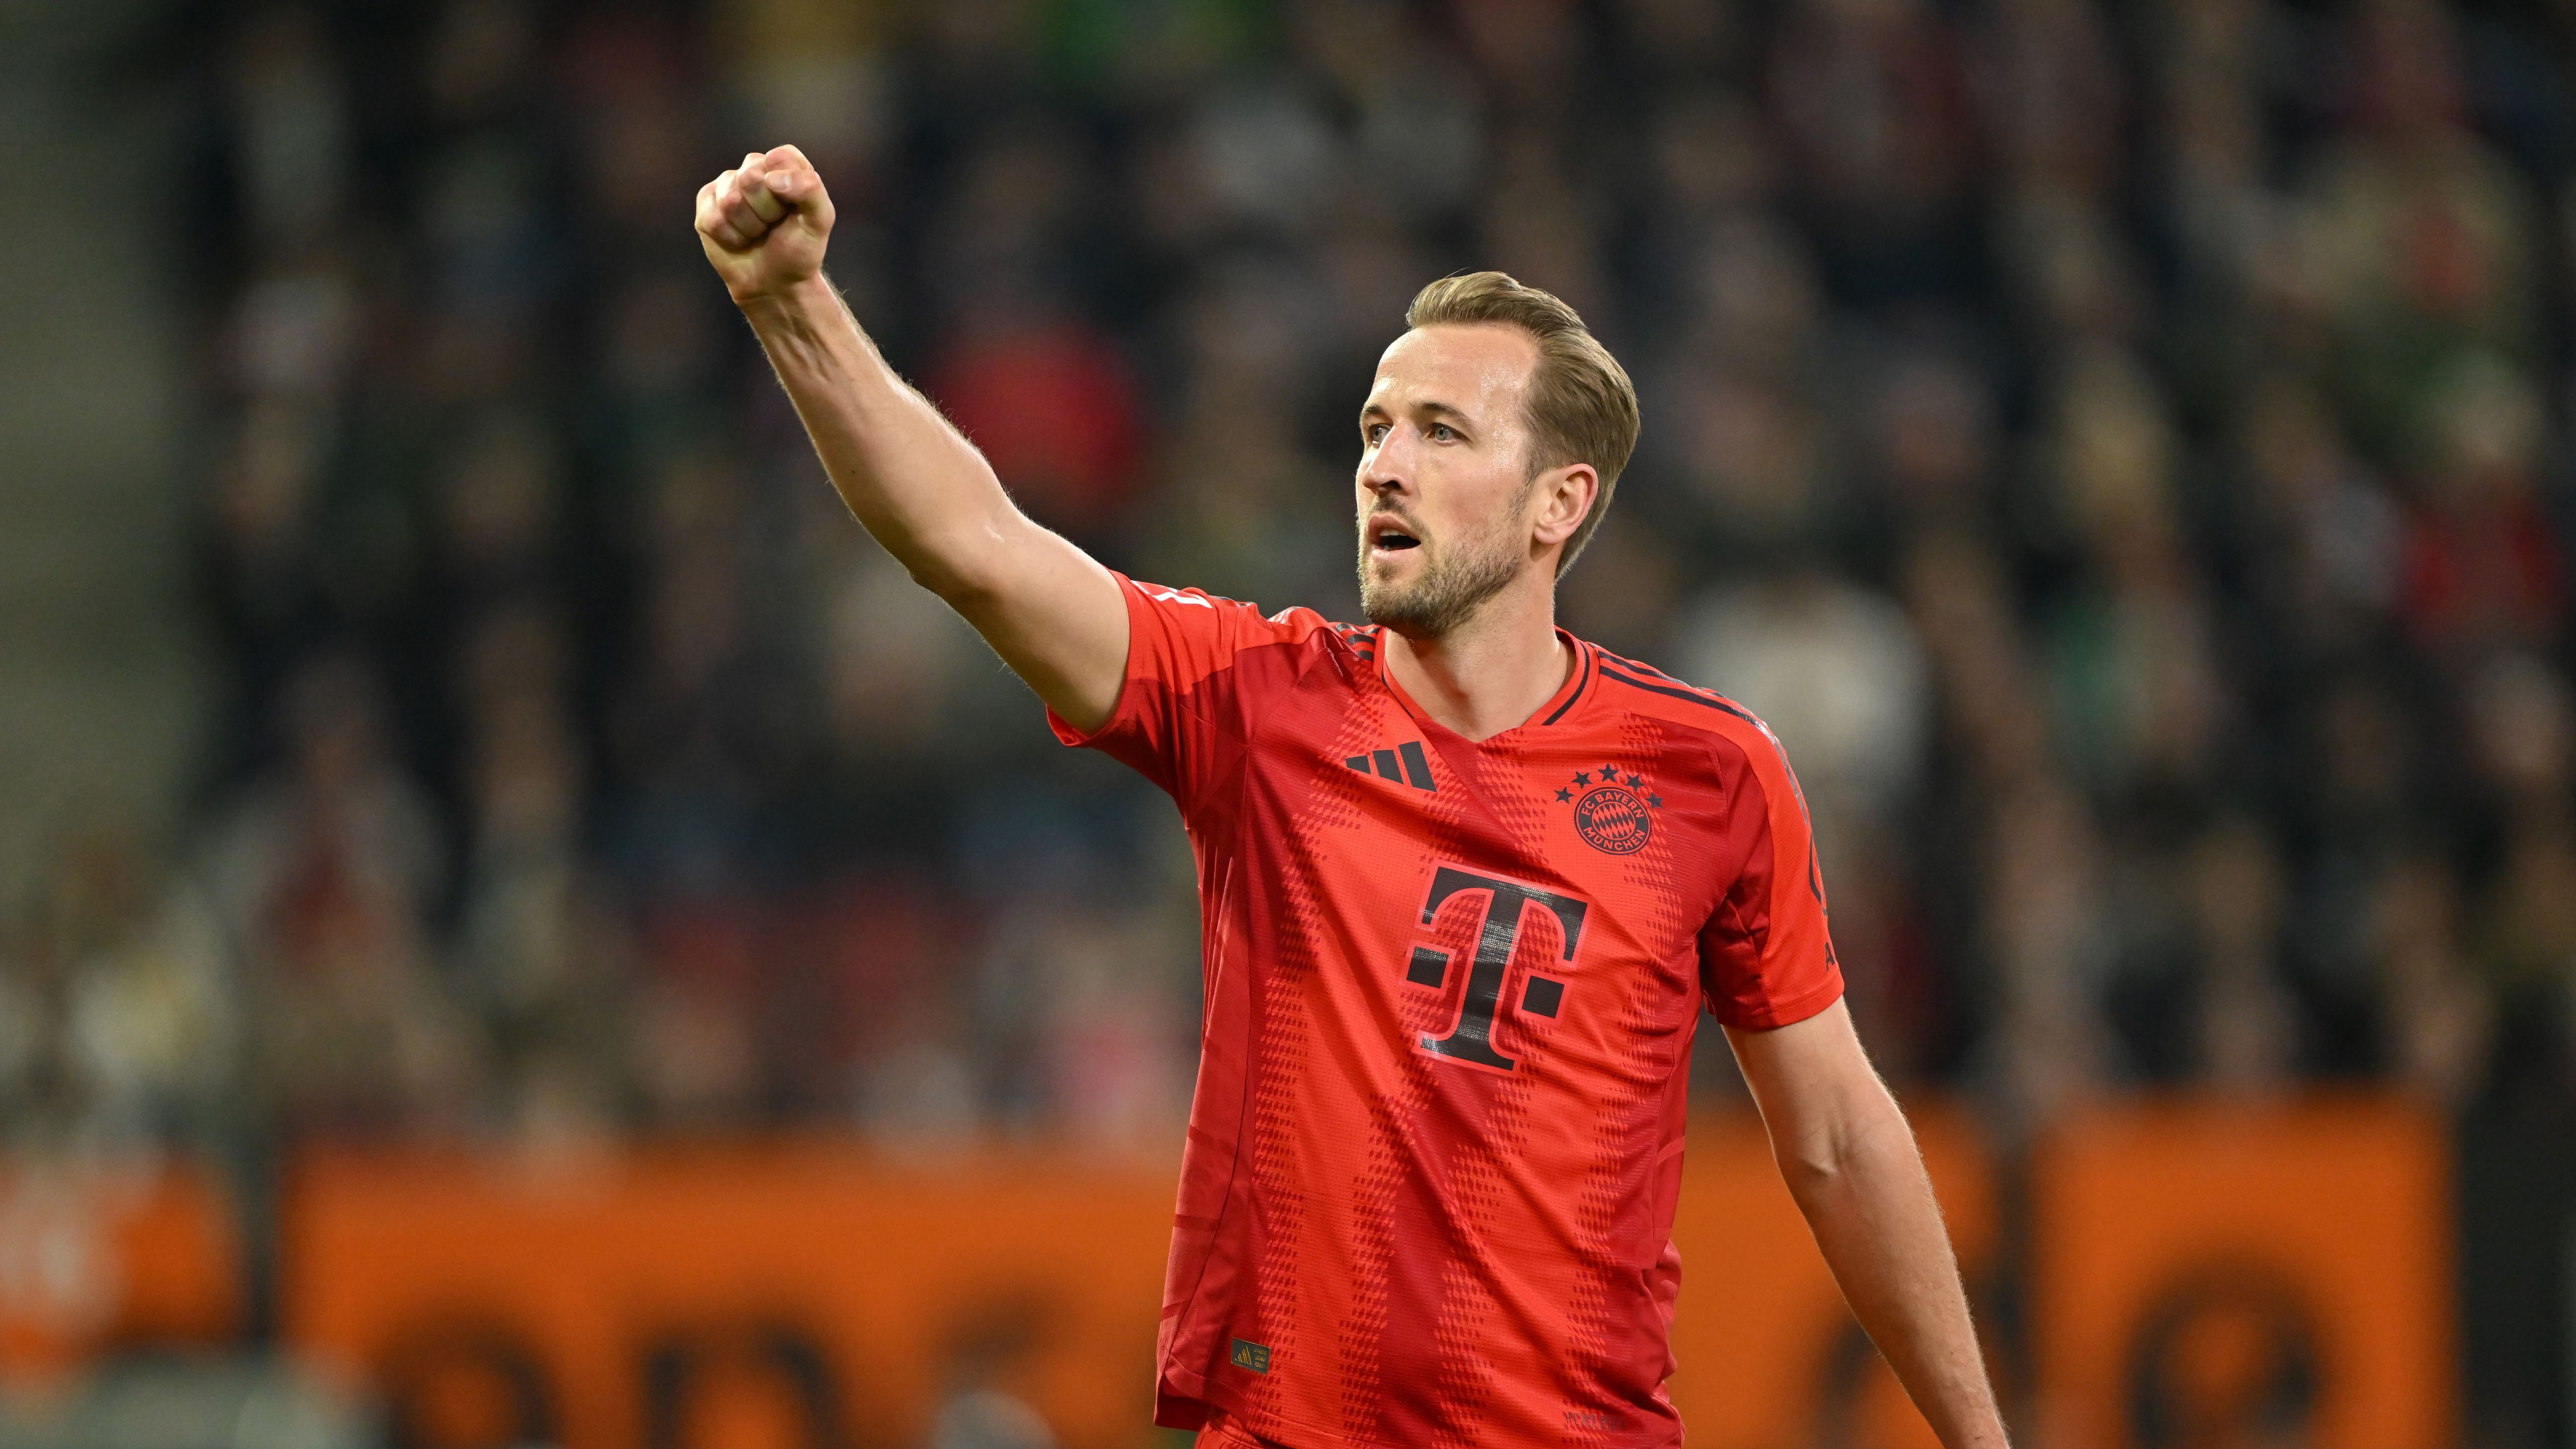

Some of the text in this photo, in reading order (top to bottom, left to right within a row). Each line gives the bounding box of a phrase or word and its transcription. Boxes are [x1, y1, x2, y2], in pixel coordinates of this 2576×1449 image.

[1581, 792, 1644, 818] FC BAYERN
[1420, 866, 1589, 1071] T
